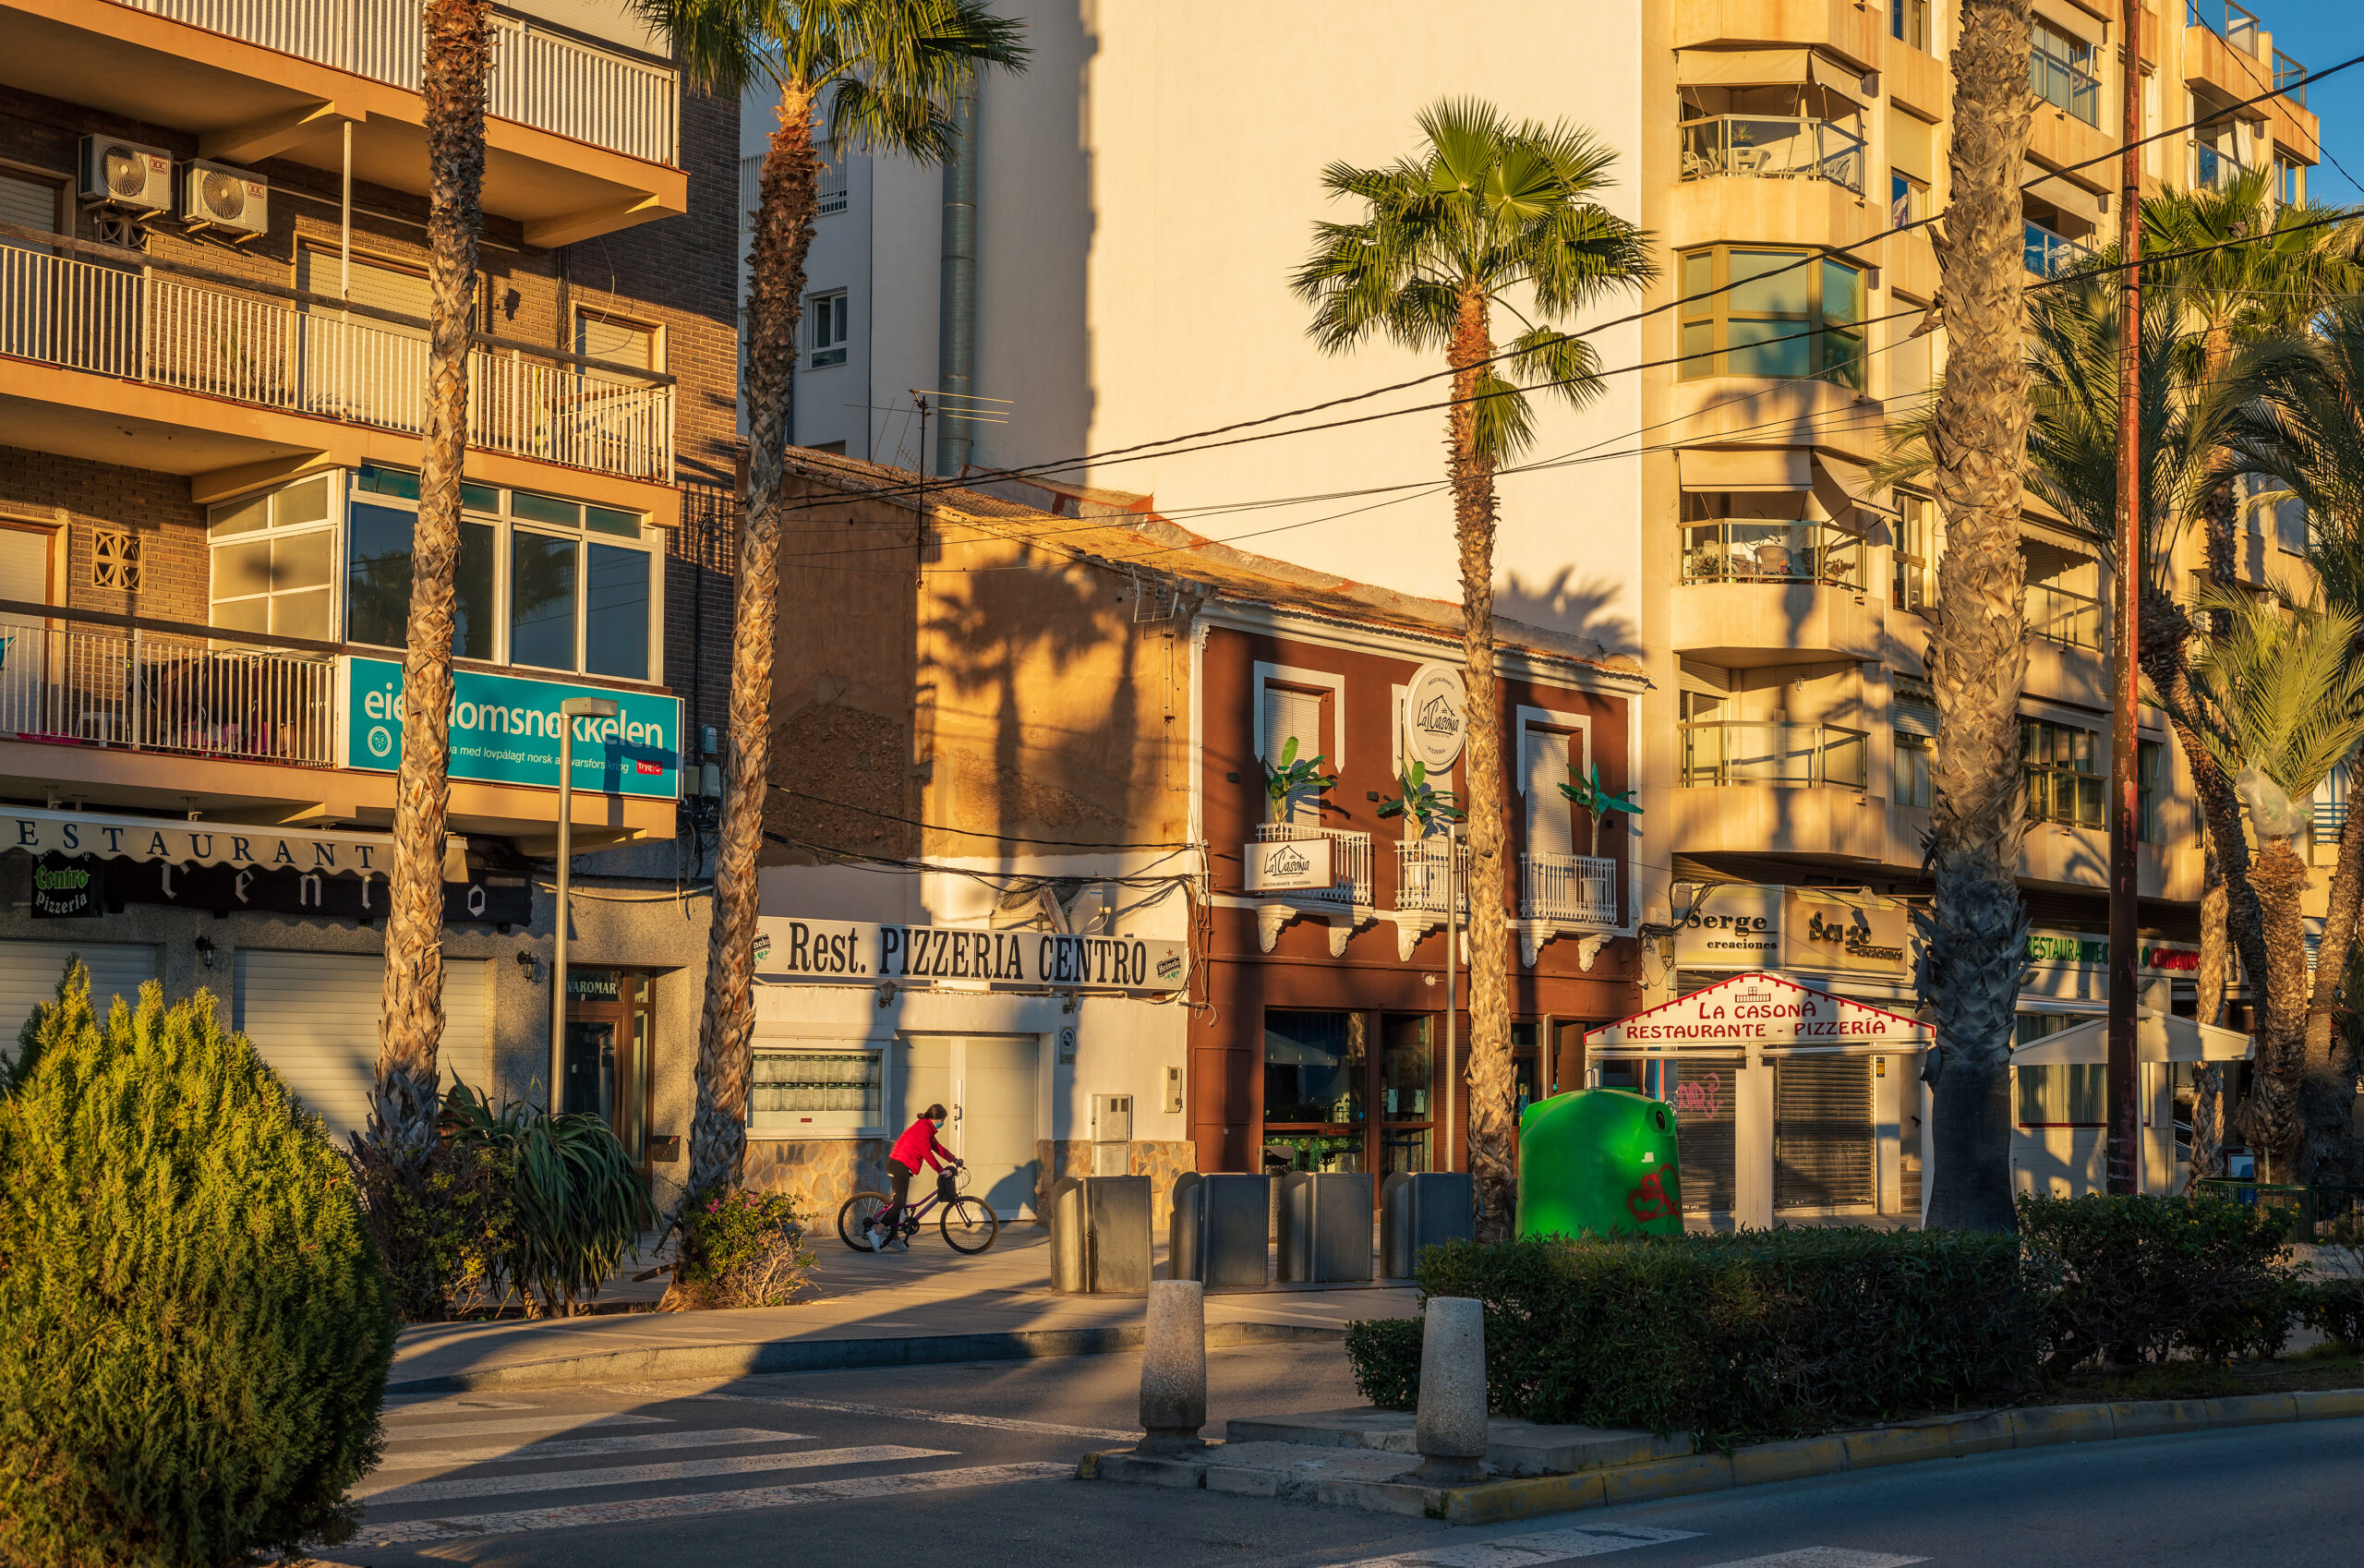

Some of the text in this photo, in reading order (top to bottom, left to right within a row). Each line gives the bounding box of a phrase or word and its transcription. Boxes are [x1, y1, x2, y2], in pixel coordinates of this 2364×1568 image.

[1417, 699, 1459, 732] La Casona
[460, 745, 481, 757] med
[483, 747, 525, 764] lovpålagt
[527, 753, 553, 765] norsk
[555, 756, 629, 774] avarsforsikring
[35, 864, 90, 890] Centro
[35, 890, 88, 915] Pizzeria
[1686, 909, 1768, 937] Serge
[787, 922, 867, 974] Rest.
[1038, 935, 1148, 986] CENTRO
[1707, 938, 1778, 950] creaciones
[1699, 1001, 1816, 1019] LA CASONA
[1626, 1023, 1767, 1040] RESTAURANTE
[1794, 1018, 1887, 1036] PIZZERÍA
